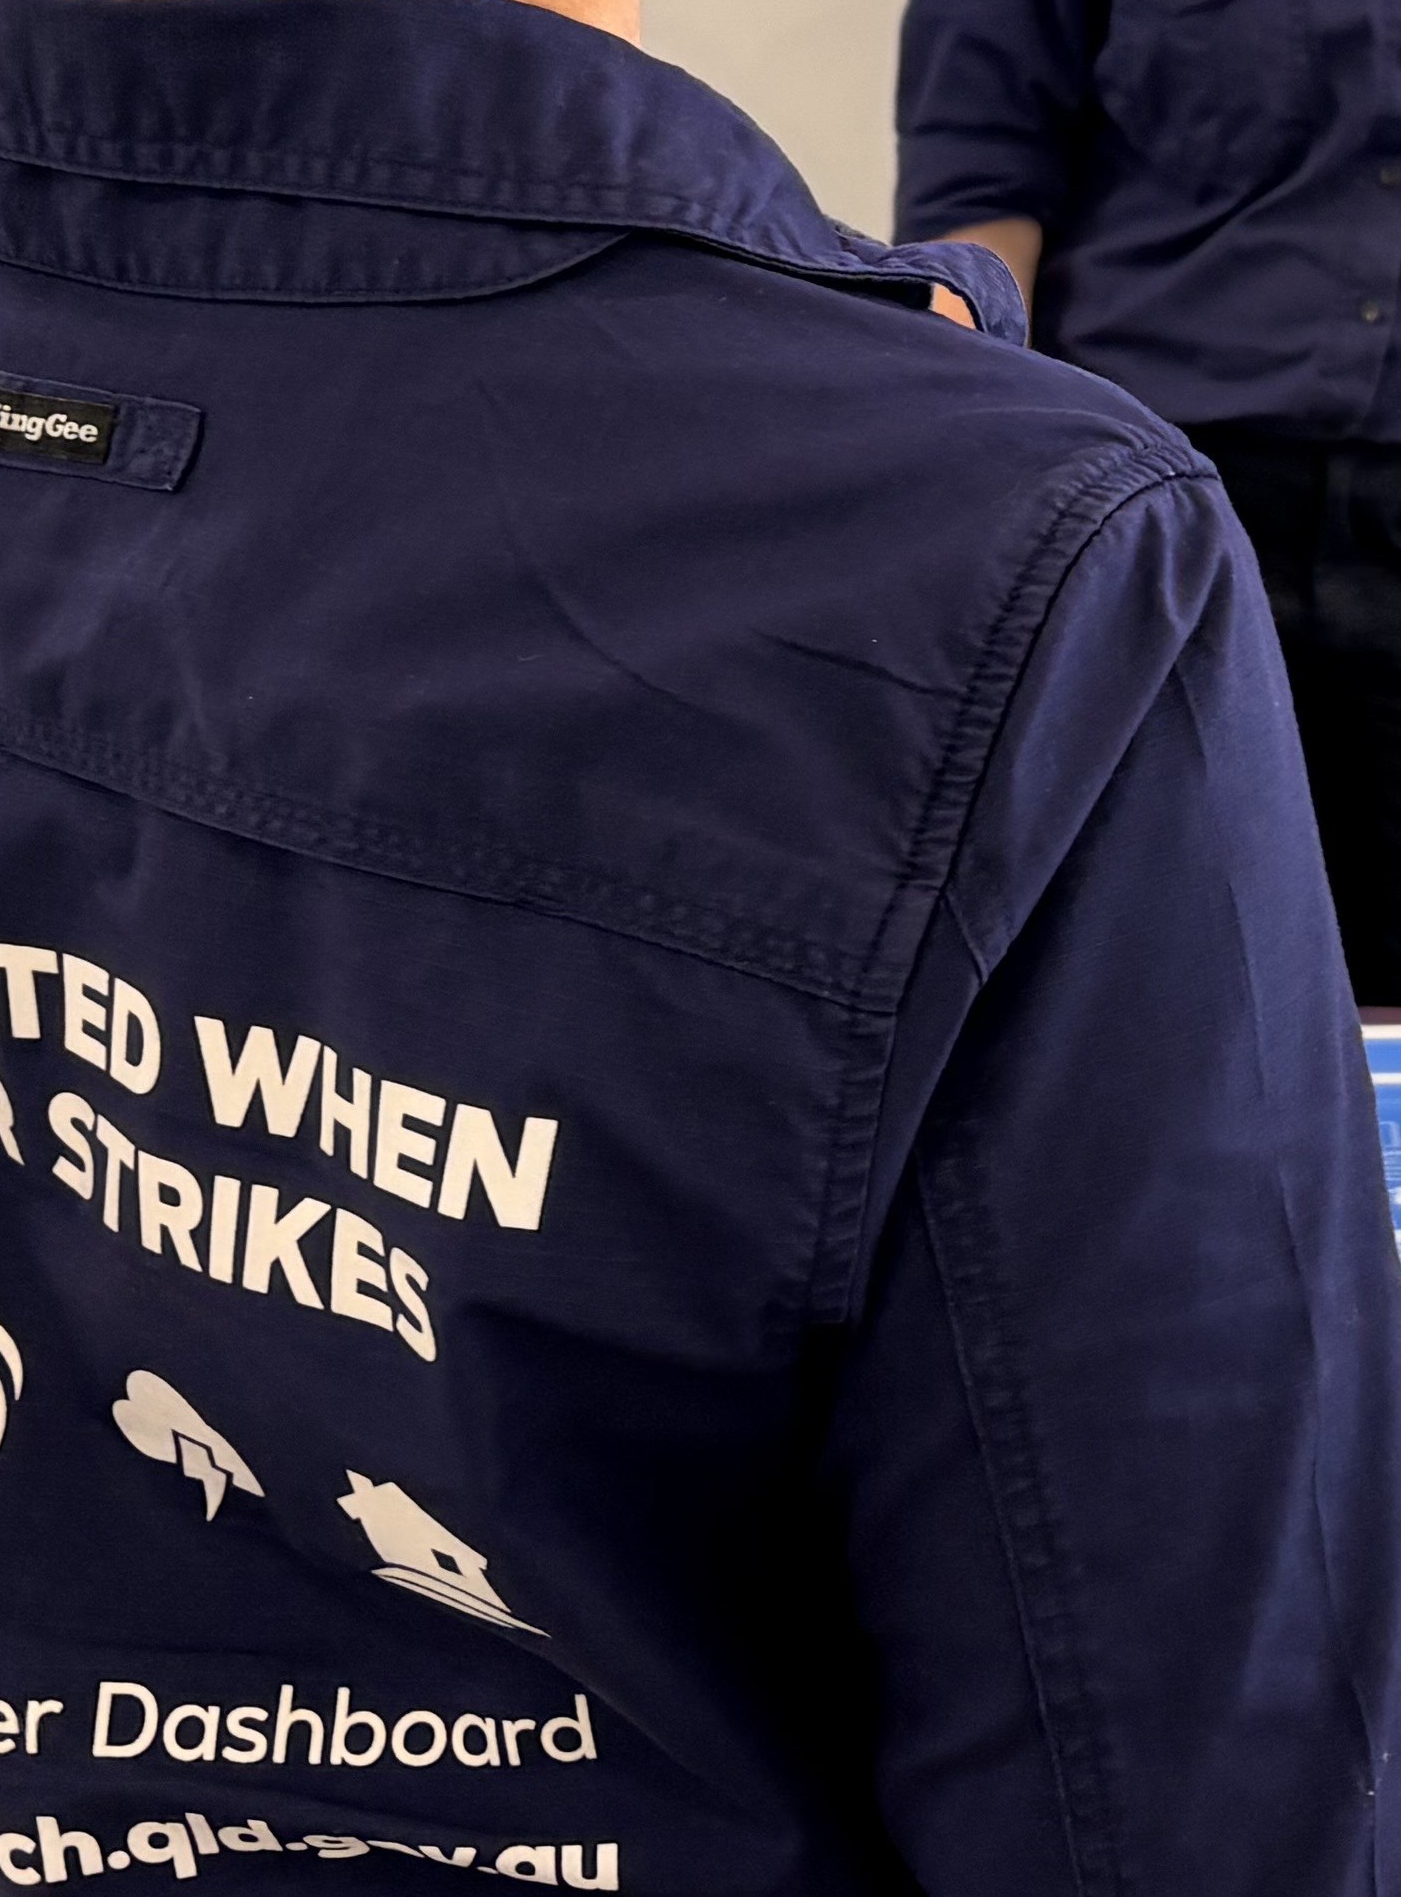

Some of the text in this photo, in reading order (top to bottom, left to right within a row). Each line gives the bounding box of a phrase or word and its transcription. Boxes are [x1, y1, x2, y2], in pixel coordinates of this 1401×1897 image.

[47, 1091, 437, 1363] STRIKES
[194, 1014, 559, 1232] WHEN
[91, 1682, 599, 1768] Dashboard
